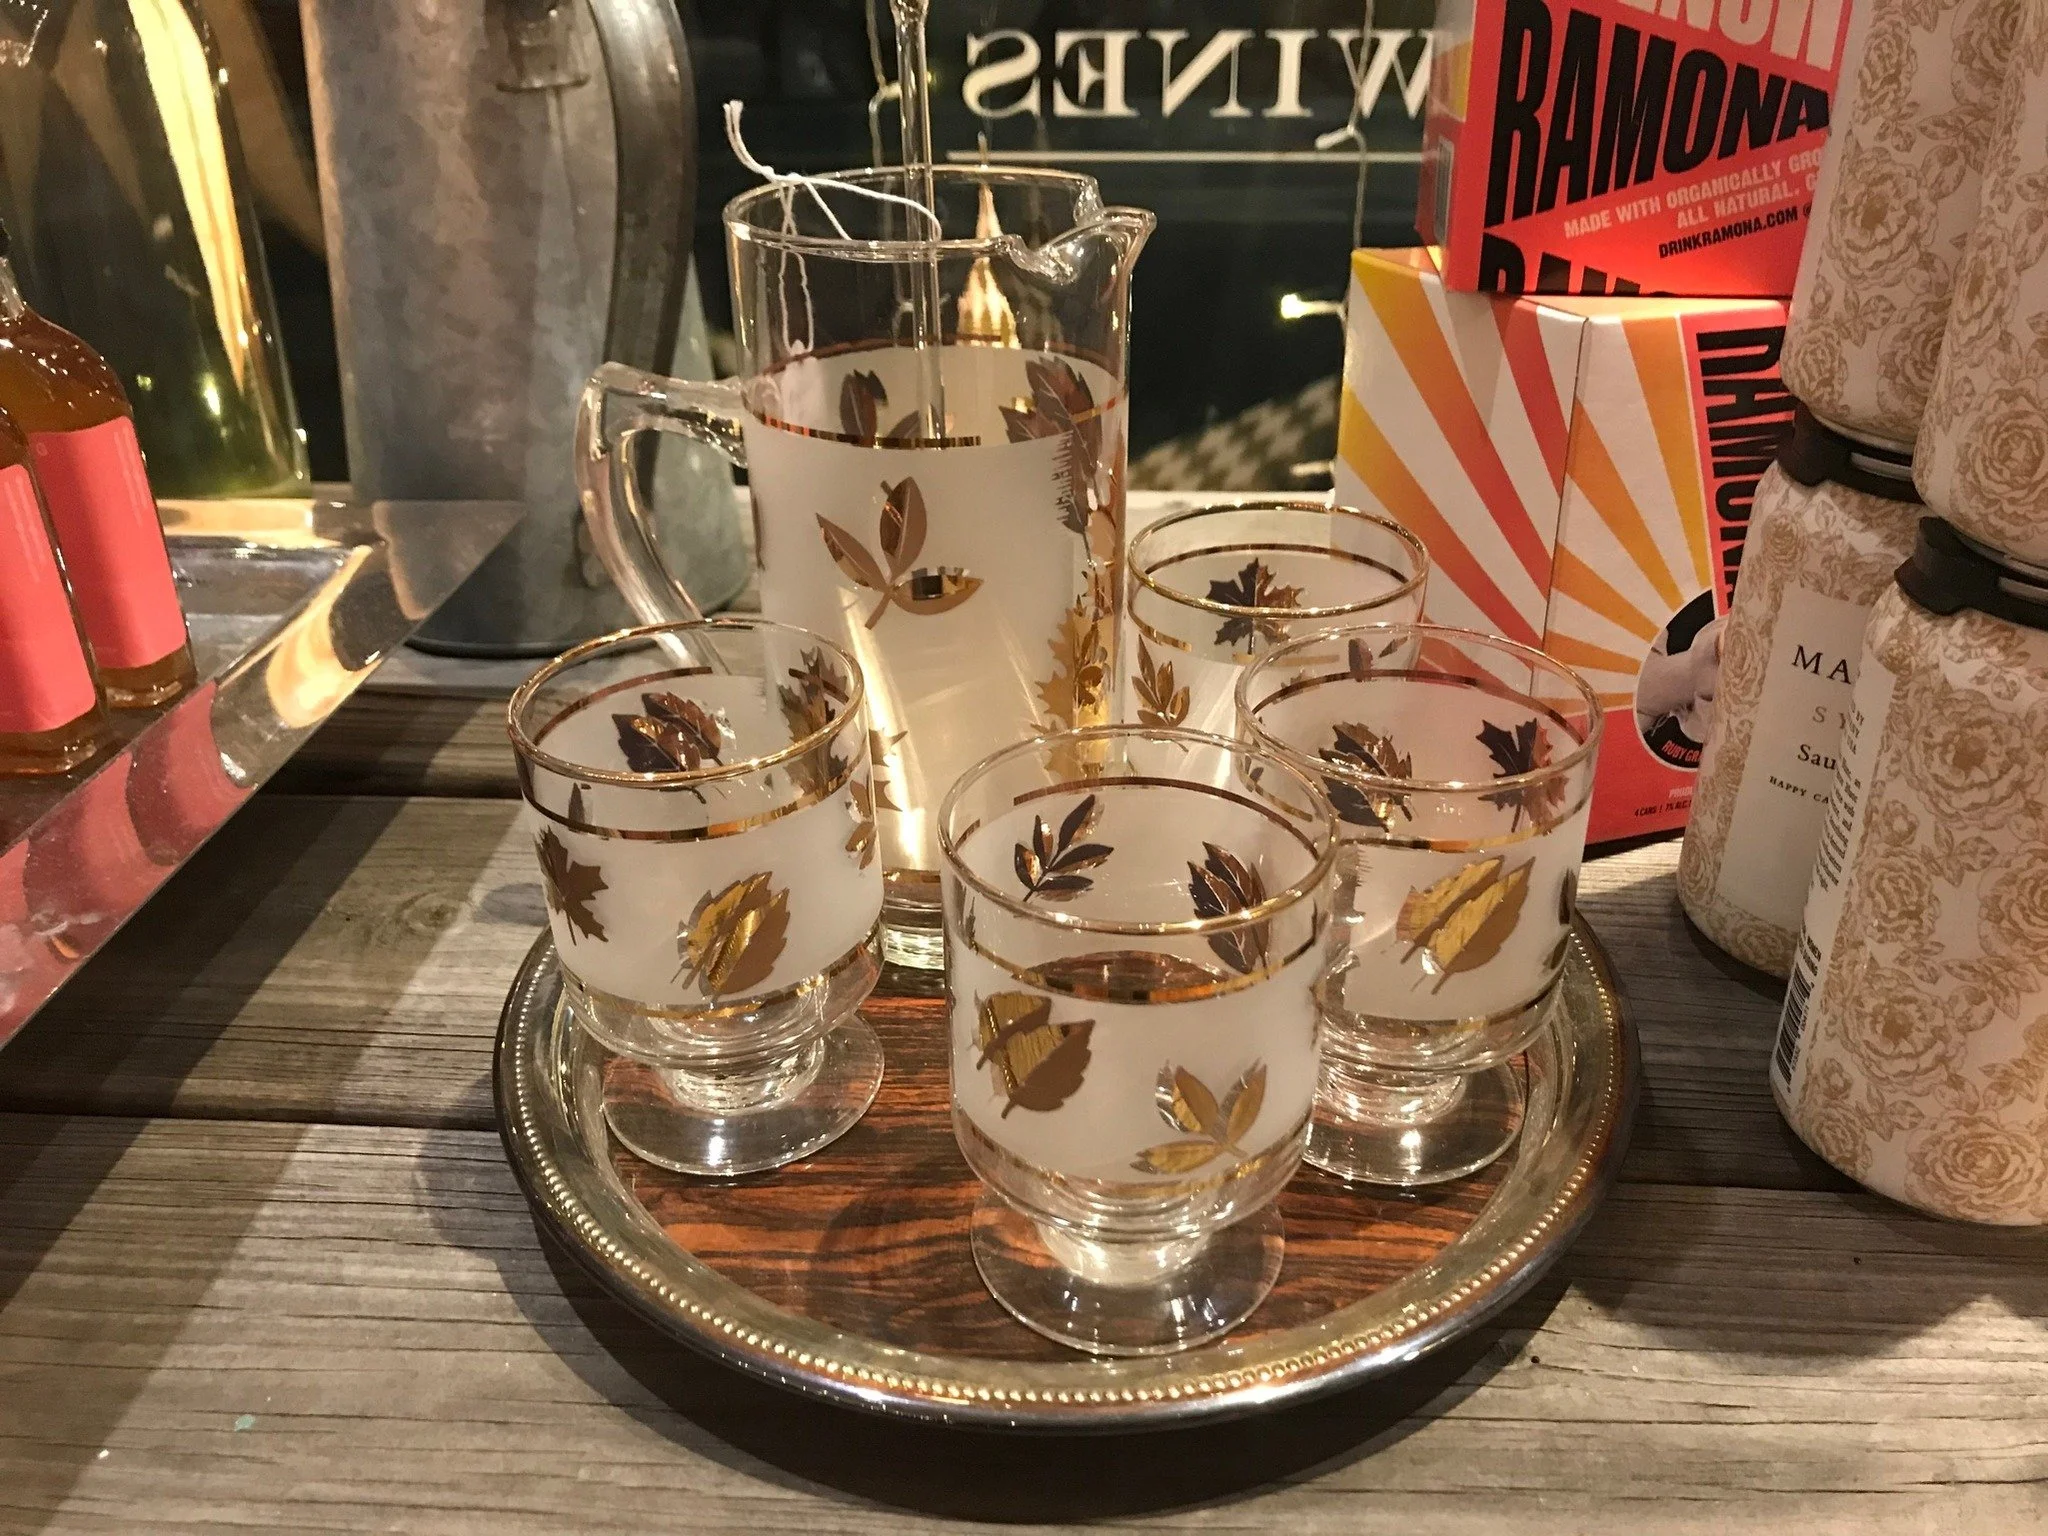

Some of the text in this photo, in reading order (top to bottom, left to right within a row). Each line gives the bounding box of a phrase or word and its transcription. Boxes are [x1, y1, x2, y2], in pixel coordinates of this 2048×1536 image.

[1484, 0, 1829, 228] RAMONA
[1564, 210, 1612, 239] MADE
[1616, 196, 1661, 225] WITH
[1666, 159, 1782, 209] ORGANICALLY
[1677, 206, 1709, 230] ALL
[1713, 181, 1800, 218] NATURAL.
[1658, 206, 1798, 259] DRINKRAMONA.COM
[1661, 740, 1687, 760] RUBY
[1769, 776, 1807, 797] HAPPY
